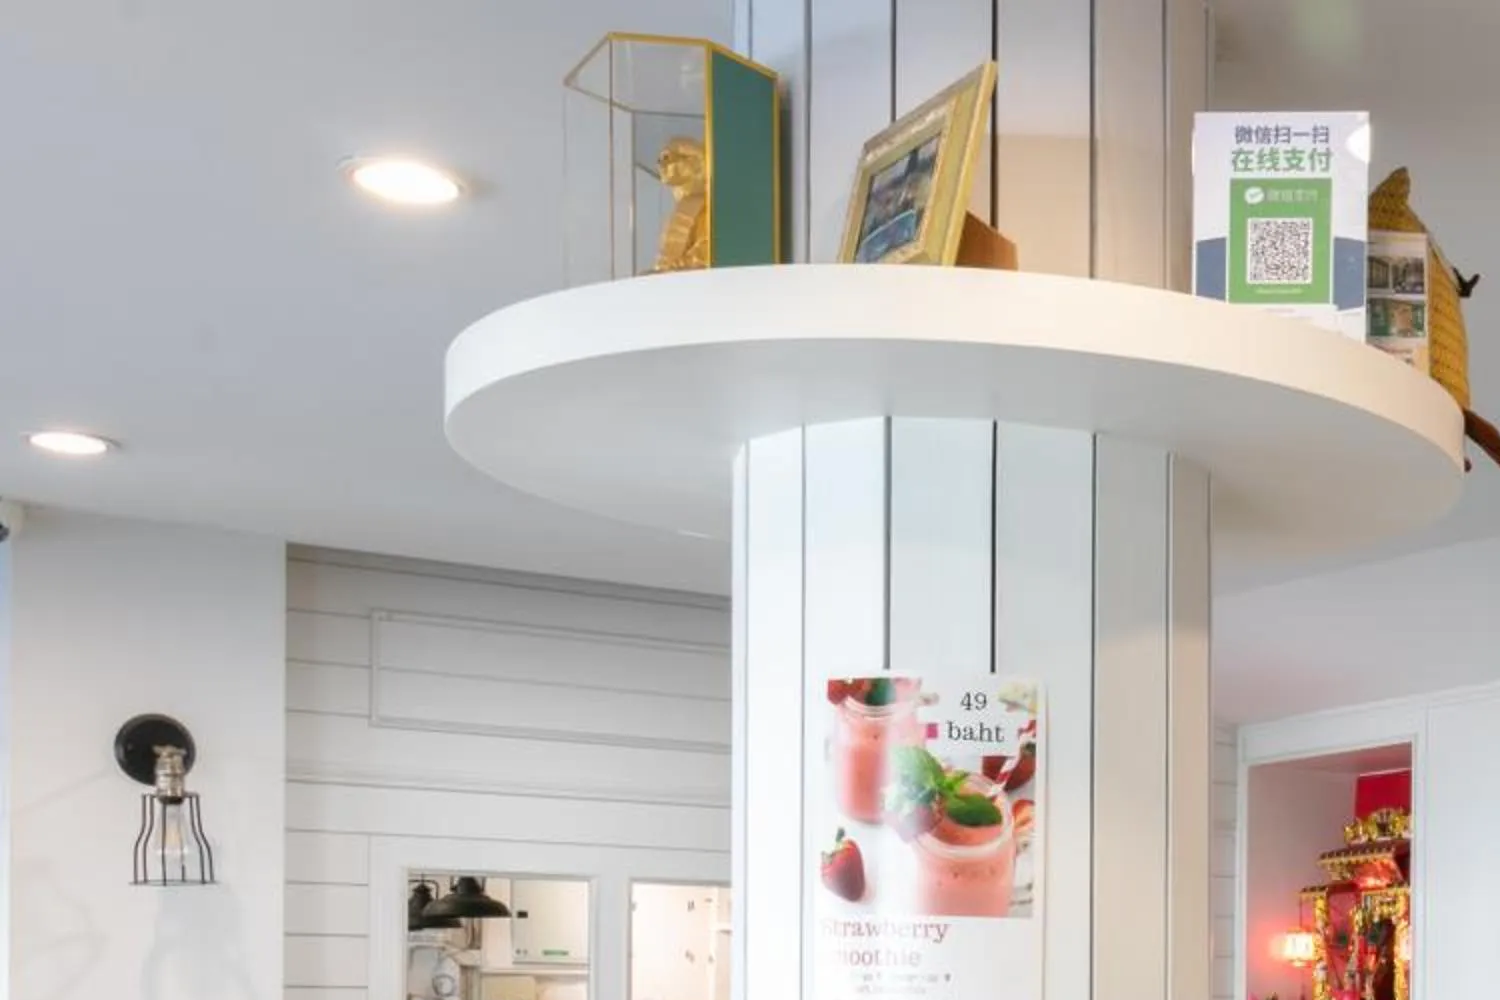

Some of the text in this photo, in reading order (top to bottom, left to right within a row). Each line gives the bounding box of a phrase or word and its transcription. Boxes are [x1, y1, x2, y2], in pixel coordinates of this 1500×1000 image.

[1234, 125, 1330, 145] 微信扫一扫
[1231, 147, 1333, 173] 在线支付
[959, 691, 988, 712] 49
[947, 720, 1005, 744] baht
